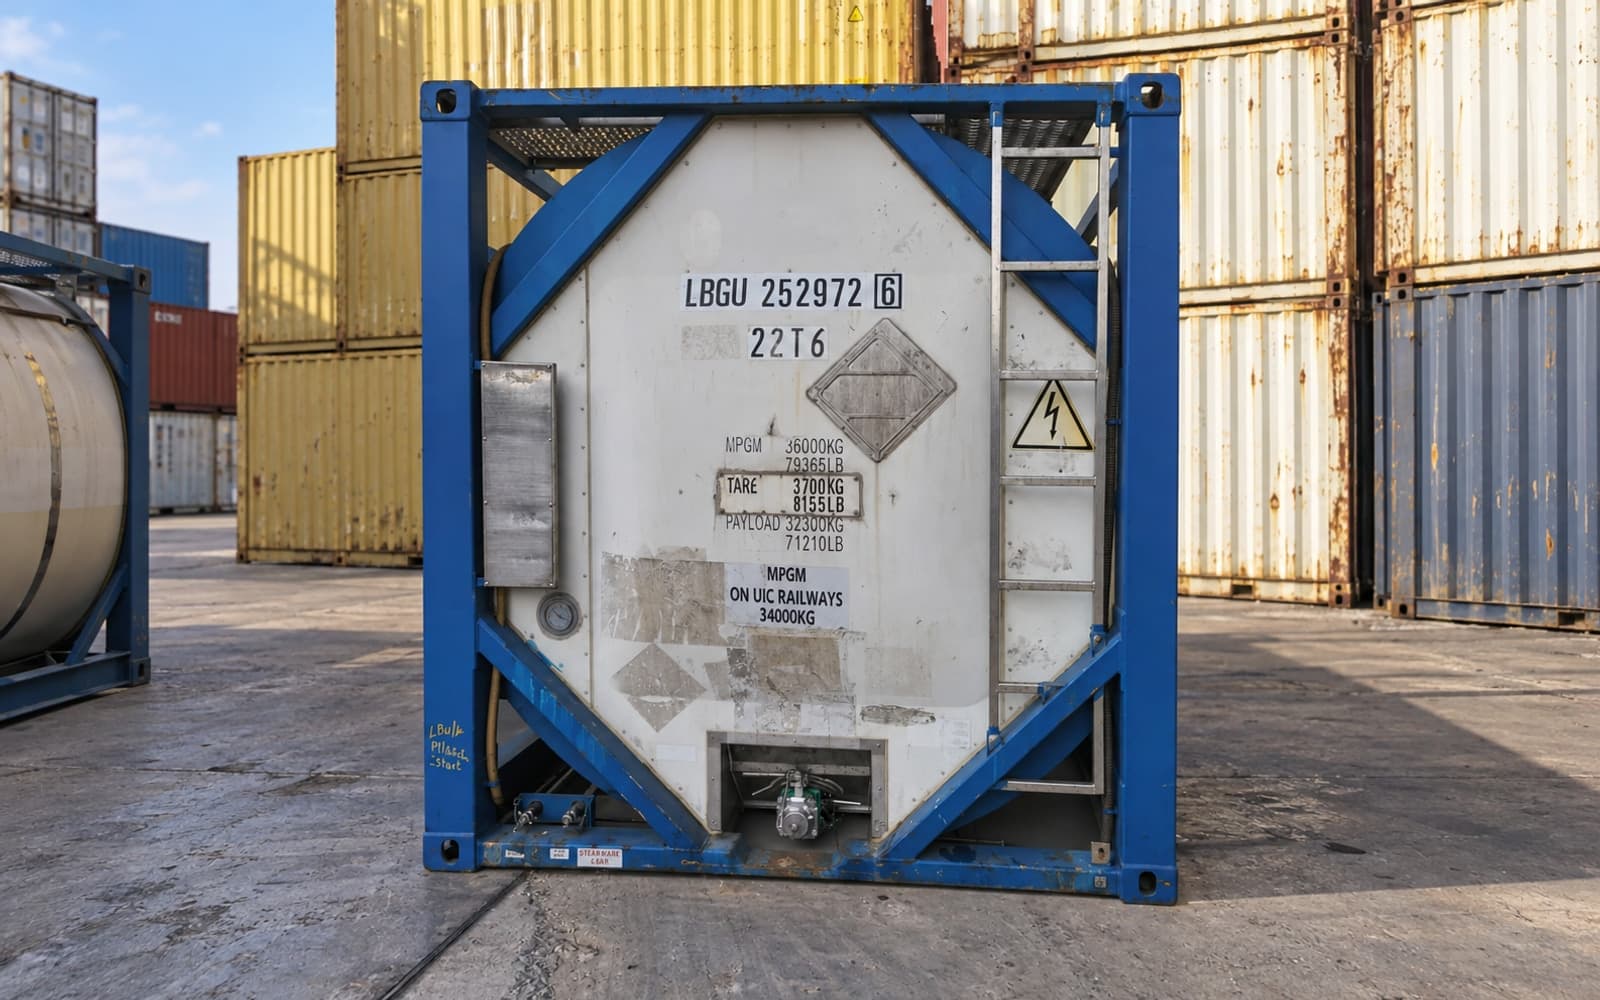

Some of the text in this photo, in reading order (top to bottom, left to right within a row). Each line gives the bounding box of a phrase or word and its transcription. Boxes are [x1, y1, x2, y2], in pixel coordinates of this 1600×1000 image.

[685, 276, 898, 308] LBGU 252972 6
[750, 327, 825, 358] 22T6
[725, 436, 844, 455] MPGM 36000KG
[785, 457, 844, 473] 79365LB
[727, 477, 844, 495] TARE 3700KG
[793, 496, 844, 513] 8155LB
[726, 515, 844, 532] PAYLOAD 32300KG
[785, 535, 844, 552] 71210LB
[767, 566, 806, 583] MPGM
[730, 586, 843, 607] ON UIC RAILWAYS
[759, 607, 815, 625] 34000KG
